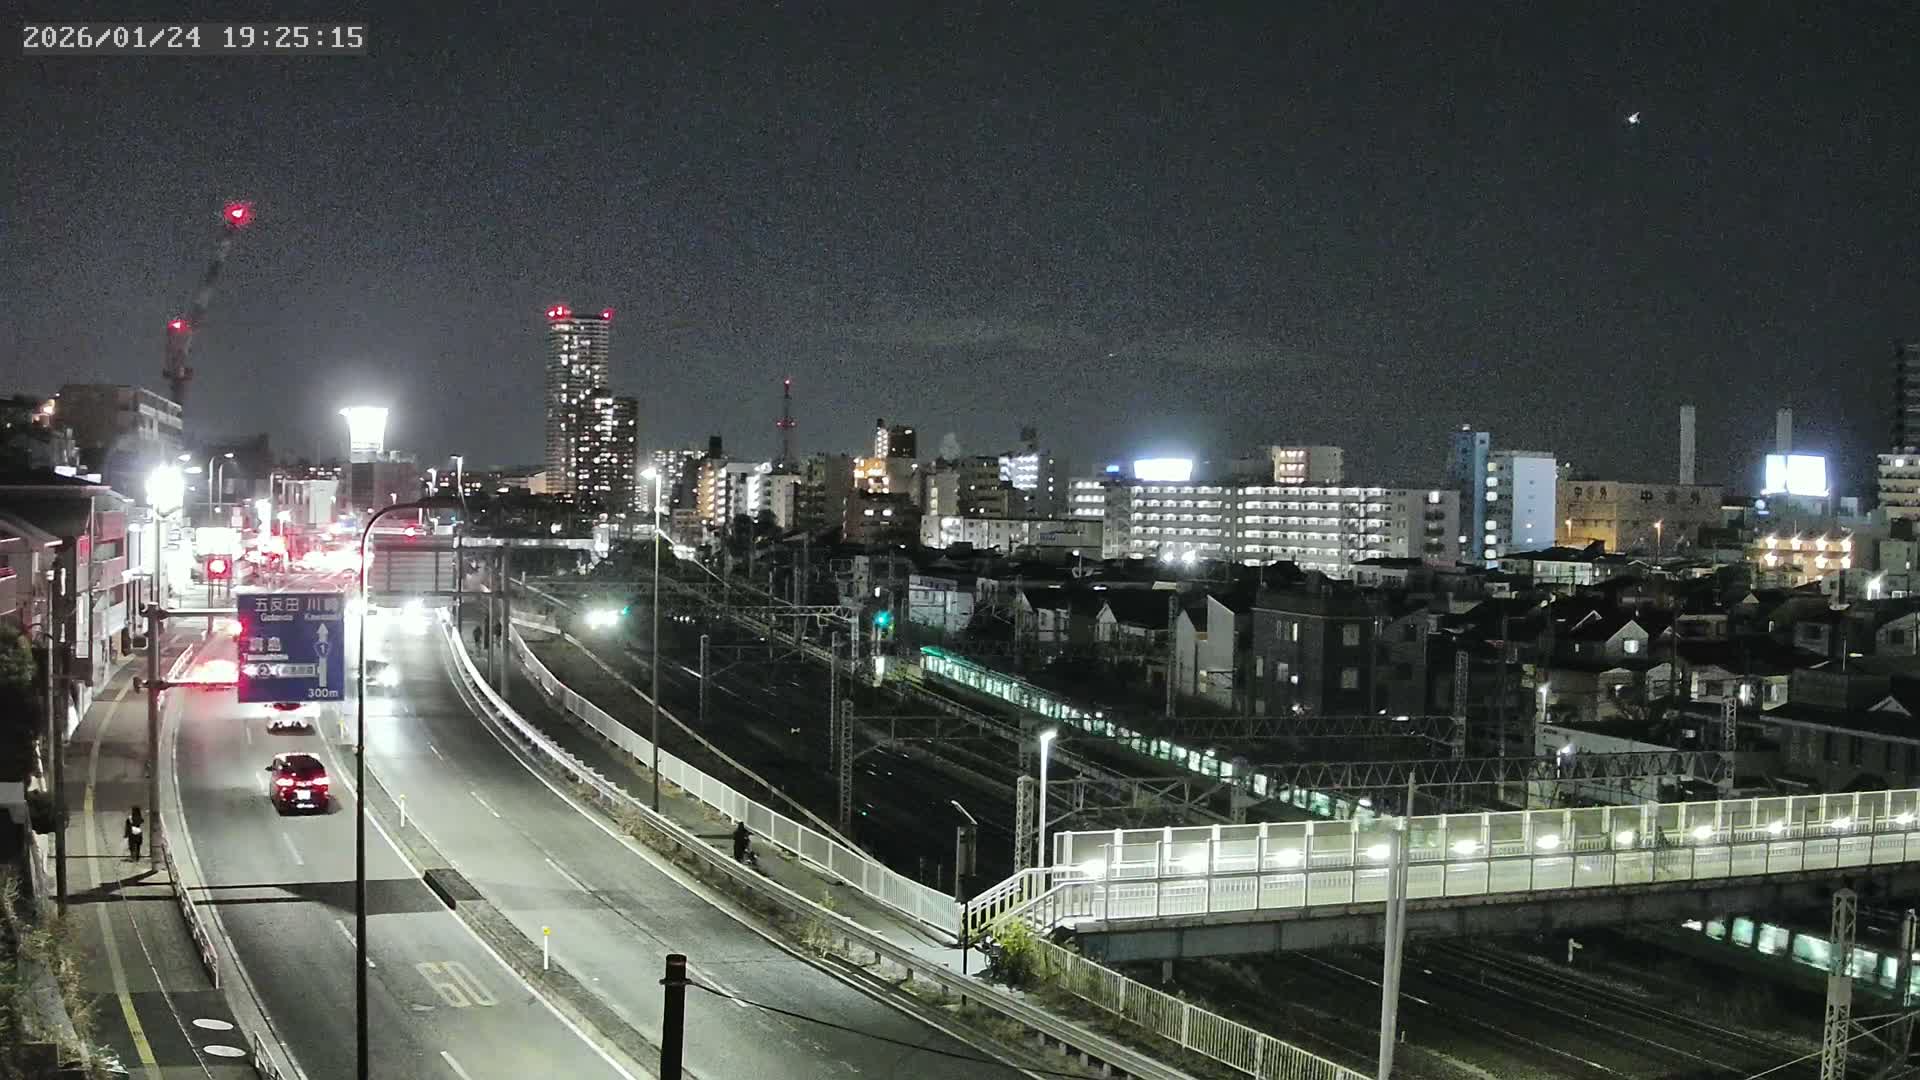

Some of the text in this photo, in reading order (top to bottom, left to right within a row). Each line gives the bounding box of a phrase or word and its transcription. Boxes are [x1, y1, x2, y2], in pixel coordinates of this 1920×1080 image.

[255, 598, 338, 612] 五反田 川
[307, 688, 338, 698] 300m
